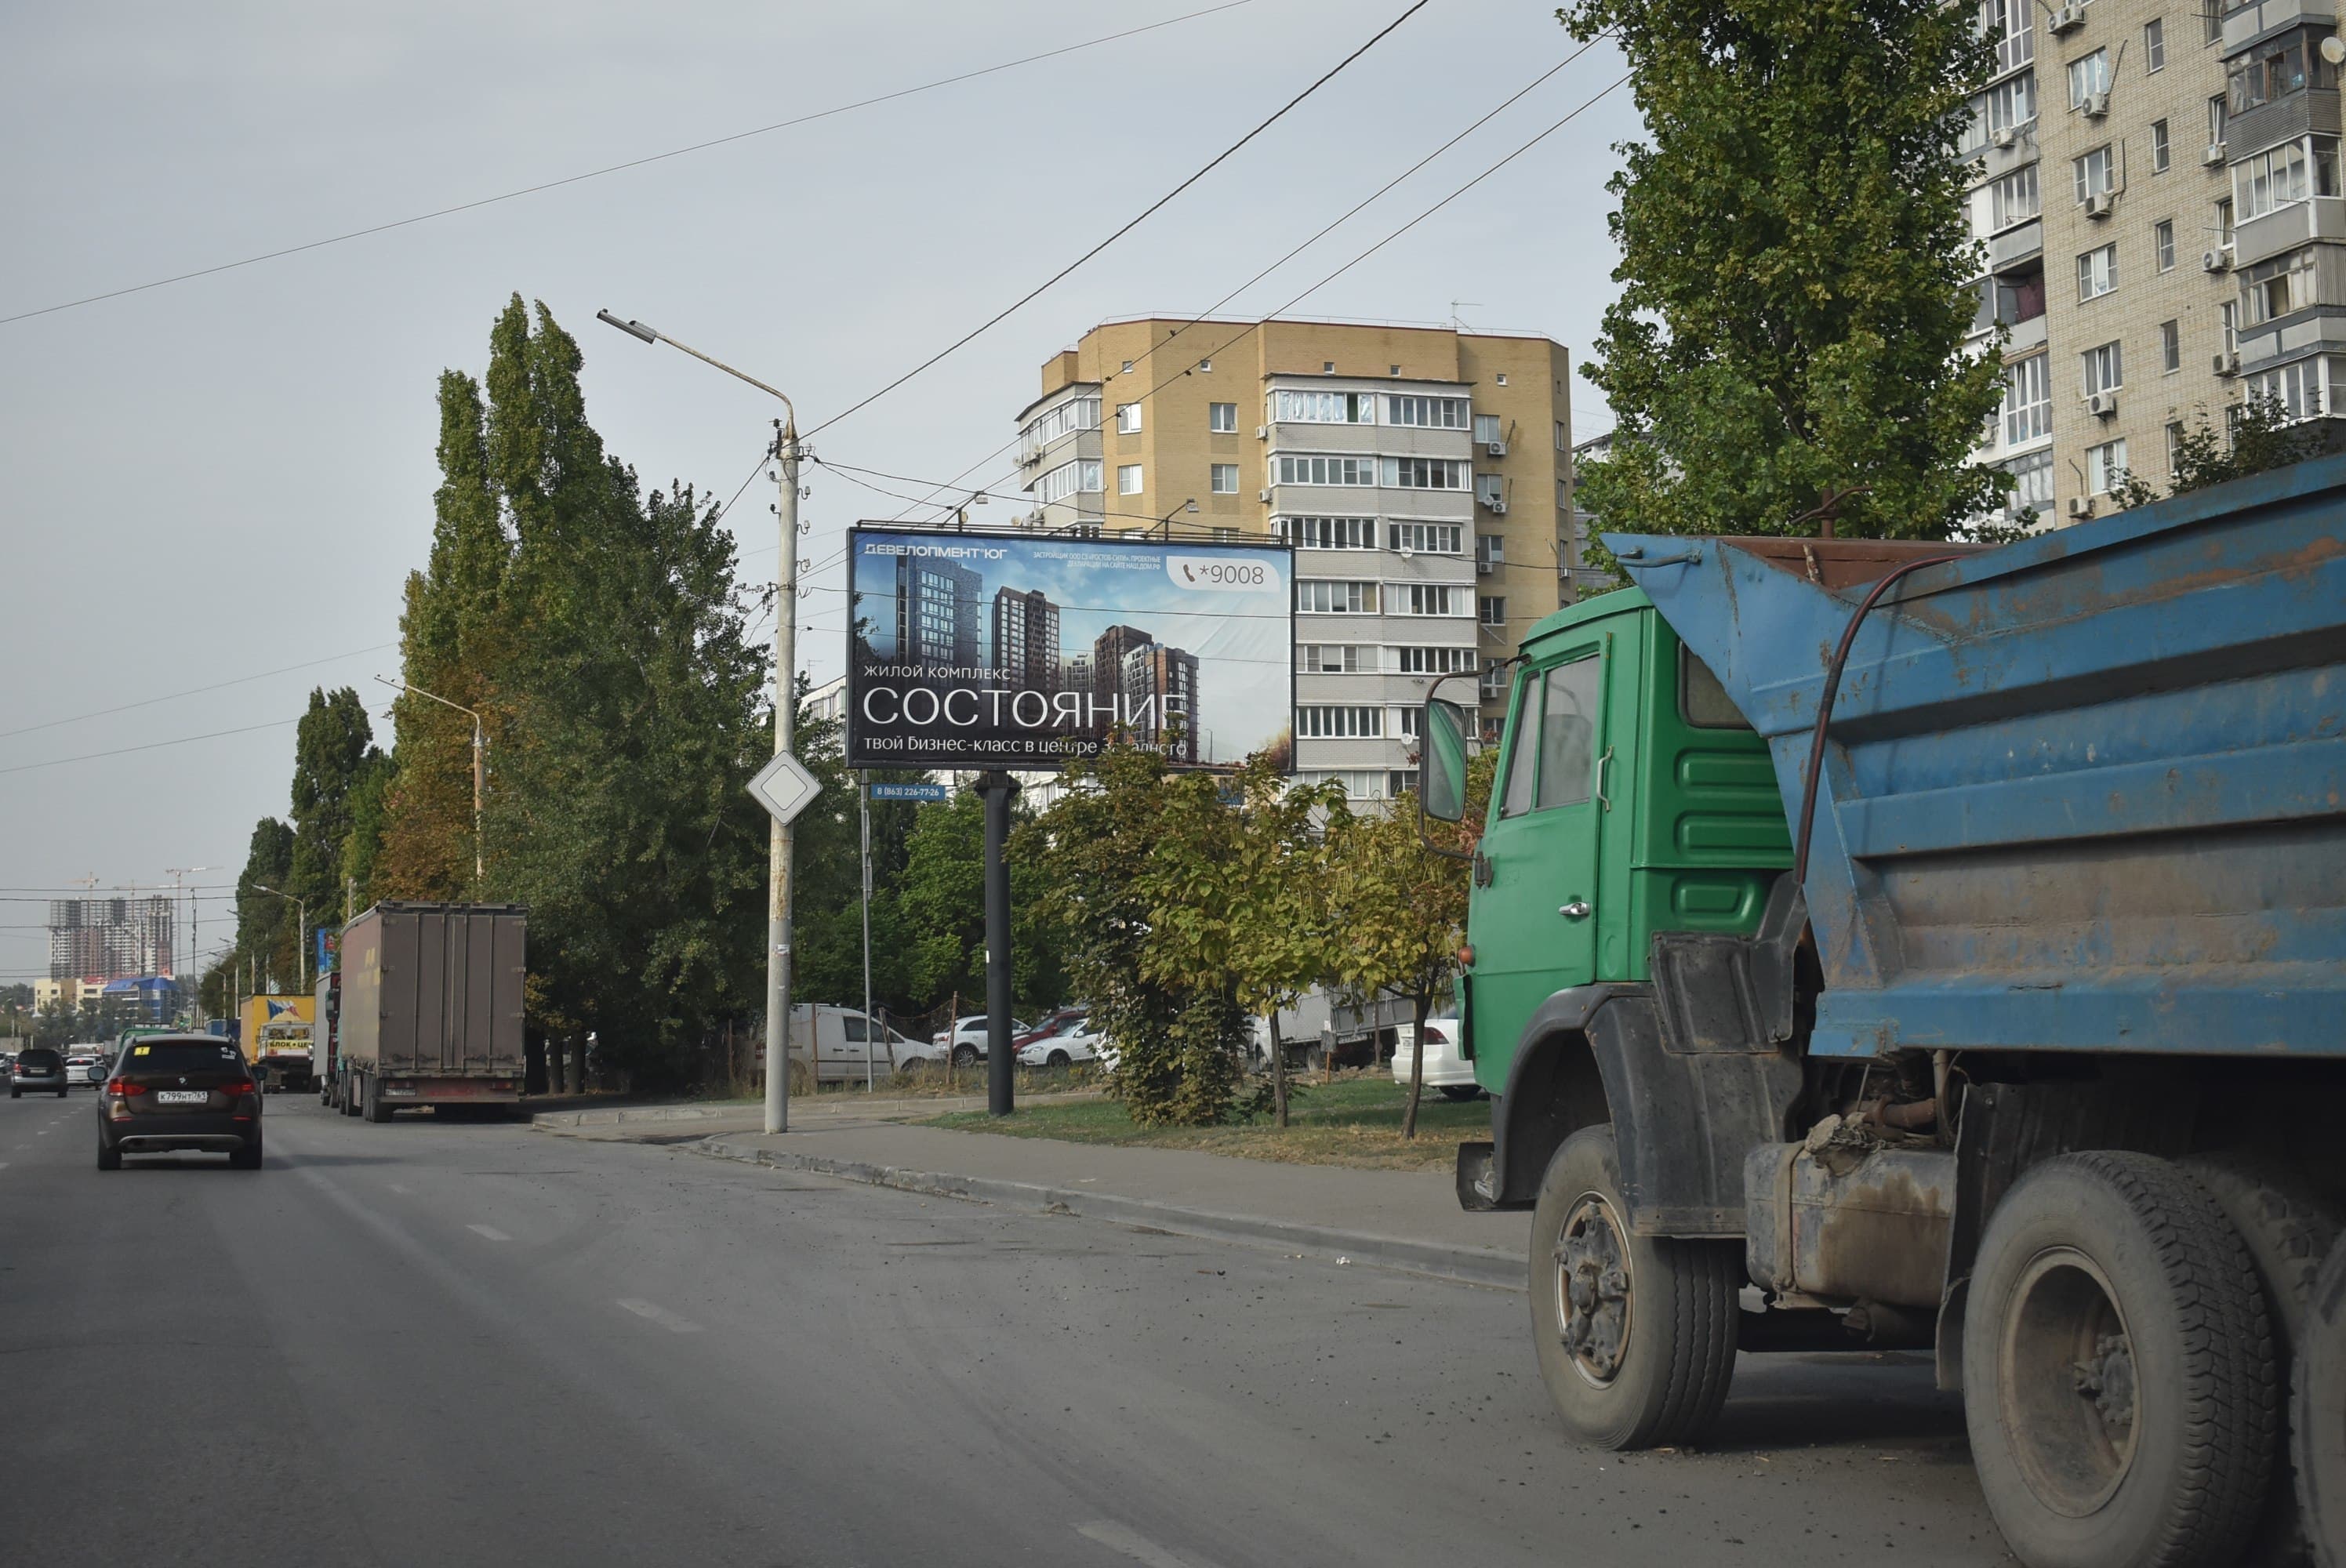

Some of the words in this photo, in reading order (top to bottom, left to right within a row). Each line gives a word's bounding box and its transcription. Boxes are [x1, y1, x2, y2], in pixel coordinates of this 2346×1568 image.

[864, 543, 980, 558] ДЕВЕЛОПМЕНТ
[984, 548, 1008, 560] ЮГ
[1033, 551, 1068, 560] ЗАСТРОЙЩИК
[864, 665, 923, 678] ЖИЛОЙ
[928, 667, 1011, 680] КОМПЛЕКС
[863, 687, 1188, 731] СОСТОЯНИЕ
[864, 735, 902, 750] твой
[1025, 741, 1034, 752] в
[884, 786, 902, 796] (863)
[904, 787, 939, 797] 226-77-26
